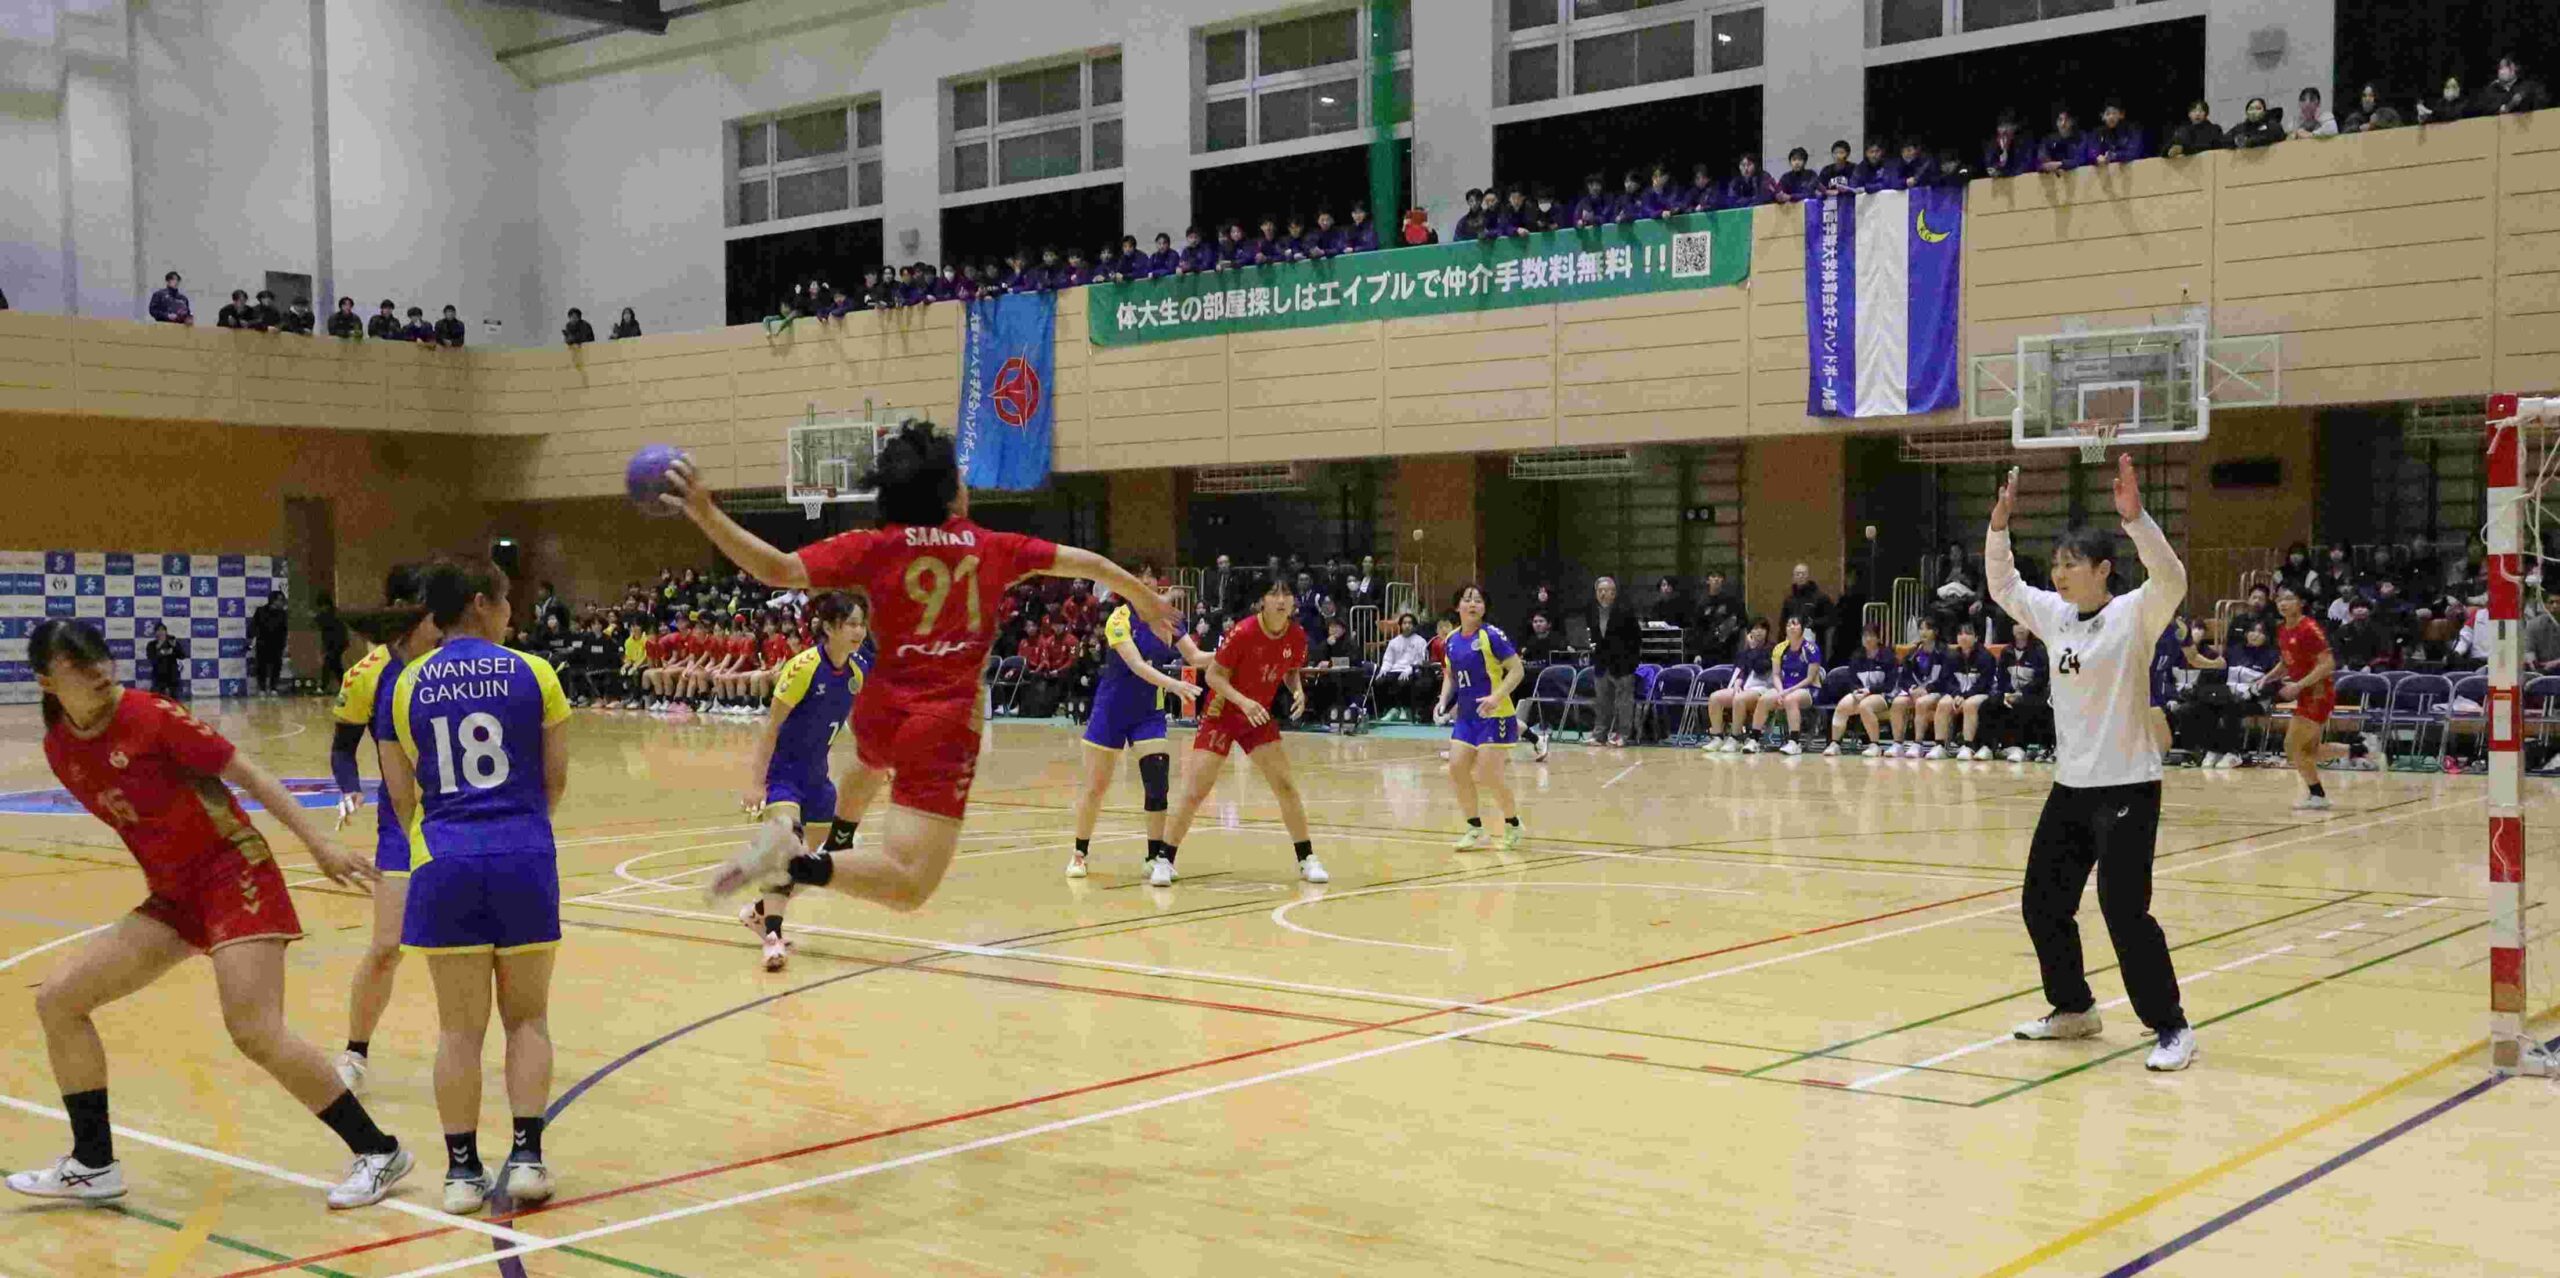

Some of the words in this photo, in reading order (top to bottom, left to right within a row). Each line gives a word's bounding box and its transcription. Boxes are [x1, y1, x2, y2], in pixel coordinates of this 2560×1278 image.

[904, 554, 981, 636] 91
[407, 657, 516, 685] KWANSEI
[2058, 647, 2081, 675] 24
[418, 679, 509, 705] GAKUIN
[1457, 669, 1471, 688] 21
[429, 711, 510, 794] 18
